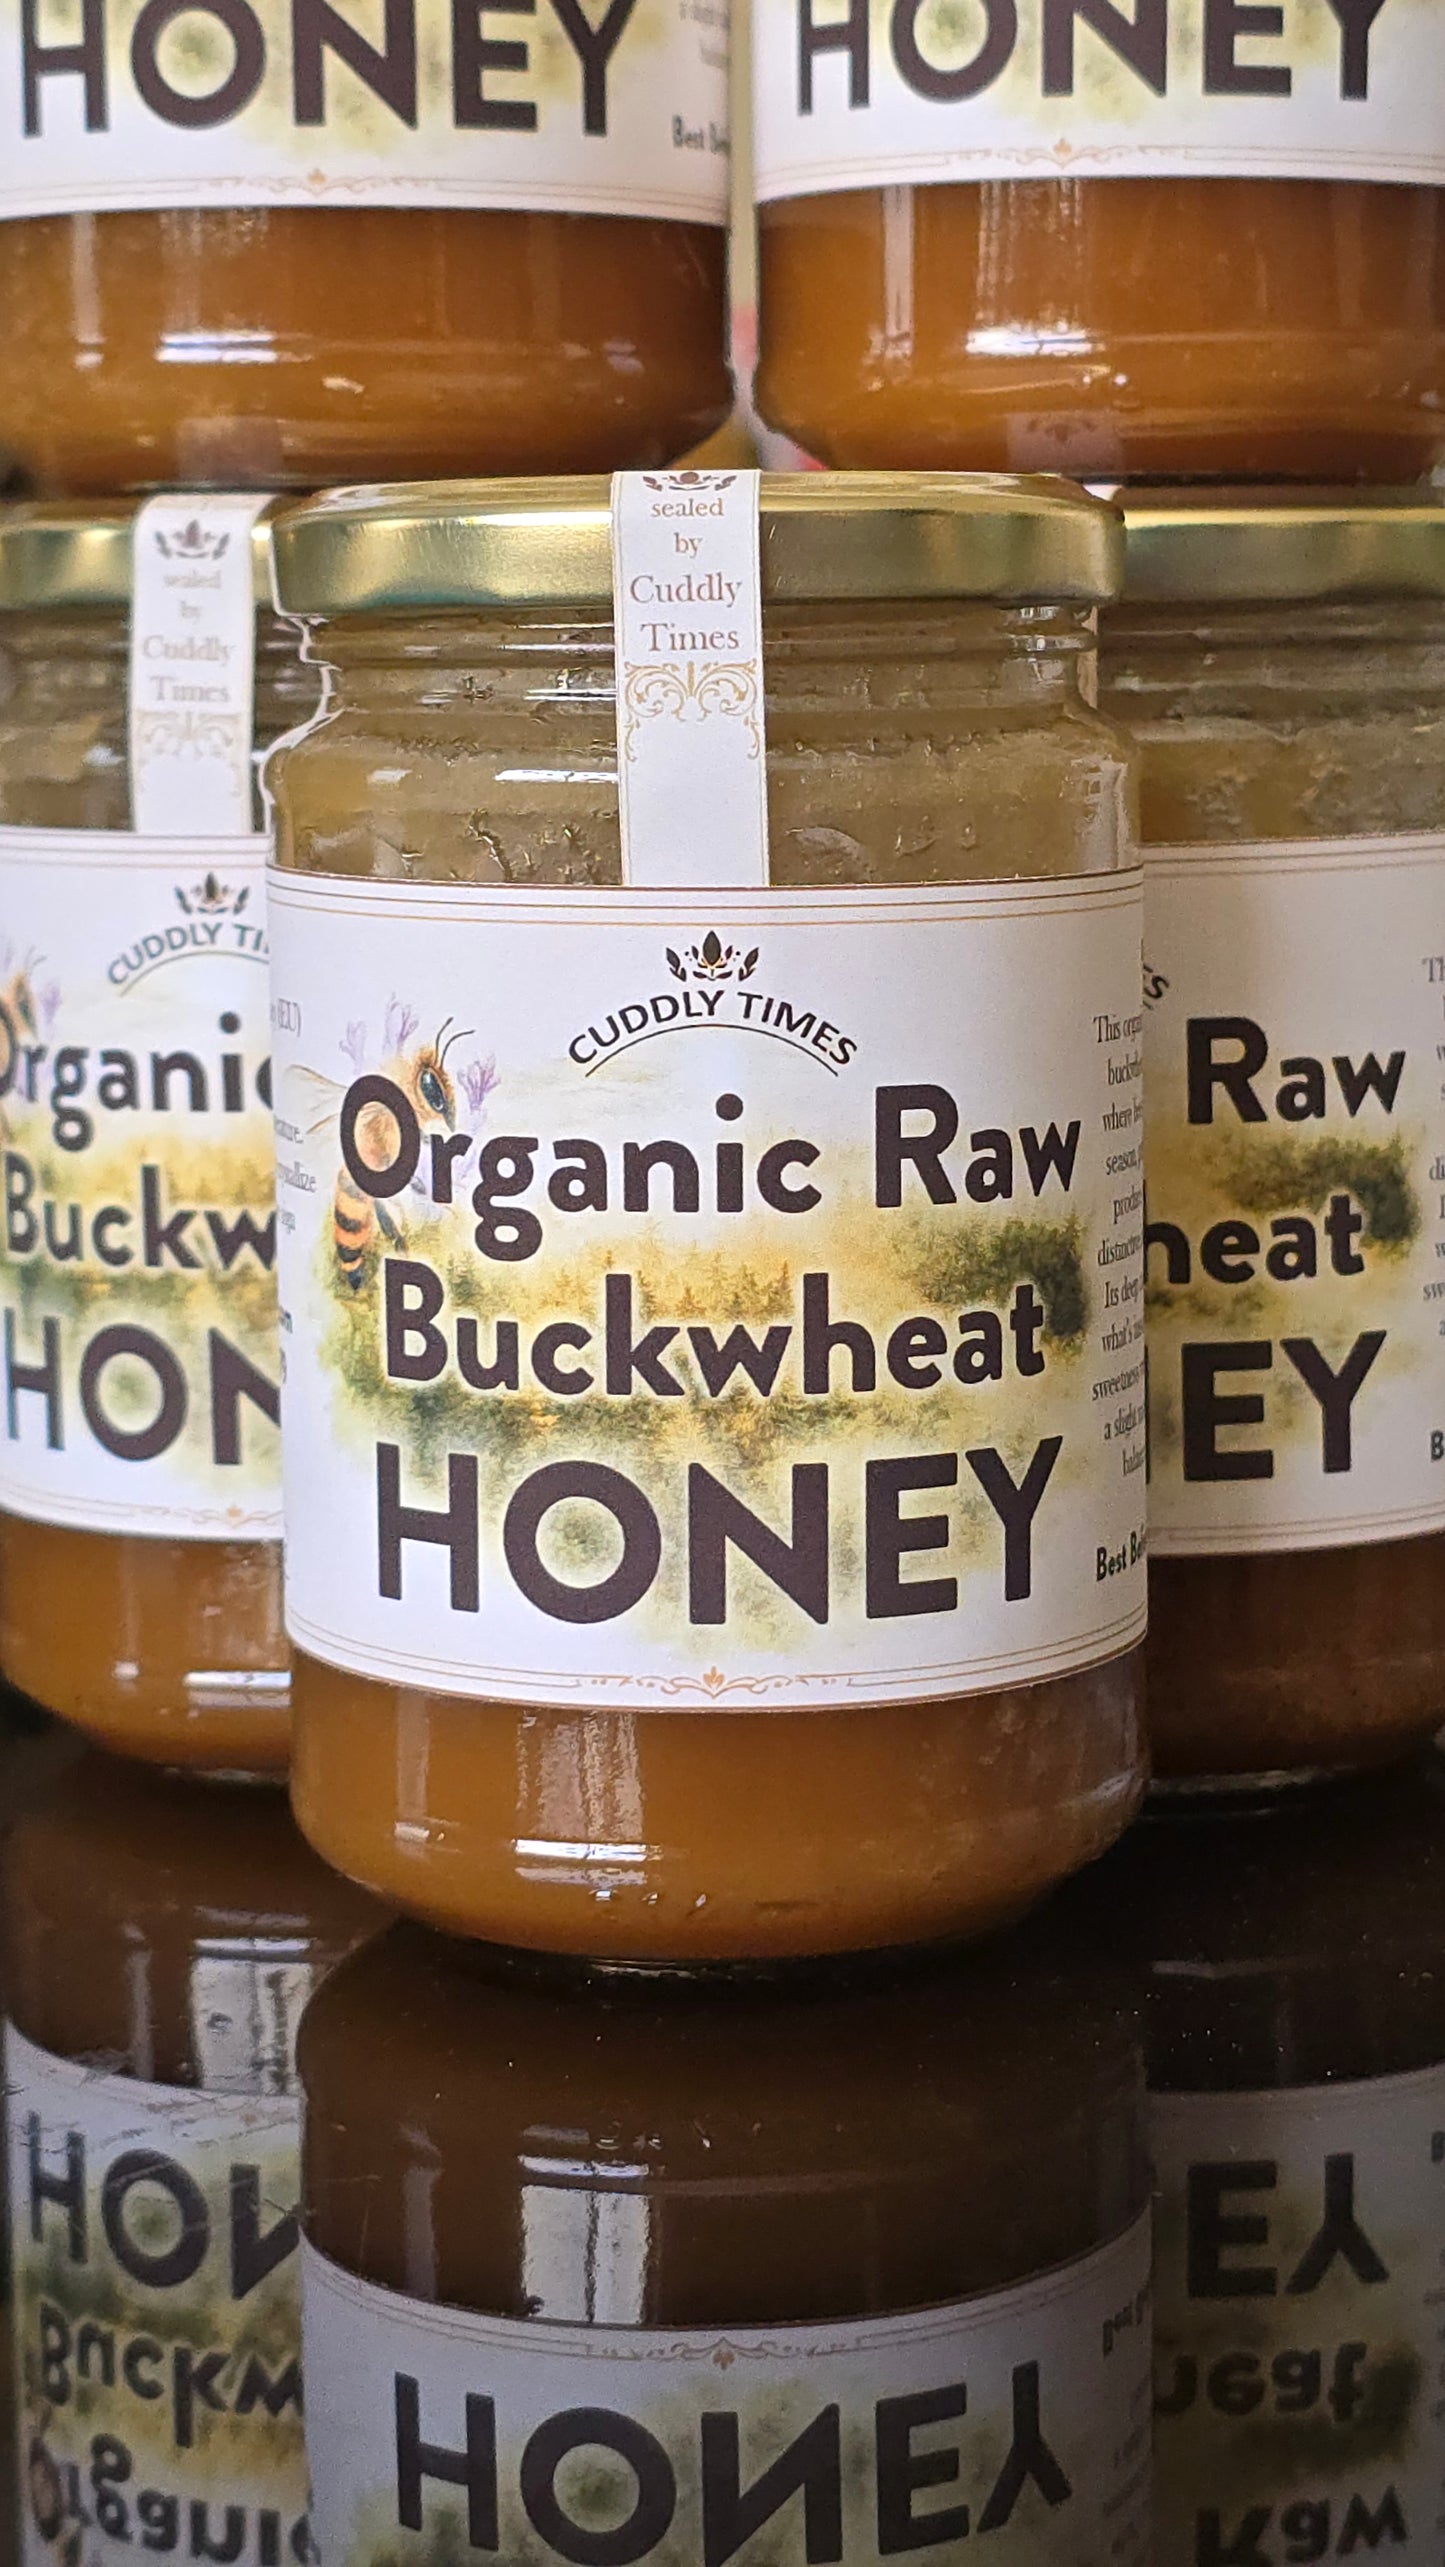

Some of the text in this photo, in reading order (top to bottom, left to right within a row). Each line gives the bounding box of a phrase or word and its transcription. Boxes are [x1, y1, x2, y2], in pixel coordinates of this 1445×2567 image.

[21, 0, 638, 139] HONEY
[797, 0, 1396, 116] HONEY
[651, 498, 725, 517] sealed
[674, 532, 702, 558] by
[630, 572, 742, 607] Cuddly
[143, 635, 236, 667] Cuddly
[640, 622, 740, 651] Times
[150, 675, 230, 703] Times
[107, 922, 270, 985] CUDDLY TI
[568, 990, 858, 1064] CUDDLY TIMES
[1094, 1014, 1121, 1043] This
[1186, 1016, 1405, 1125] Raw
[340, 1075, 1081, 1262] Organic Raw
[384, 1258, 1045, 1397] Buckwheat
[376, 1435, 1063, 1625] HONEY
[1096, 1546, 1127, 1582] Best
